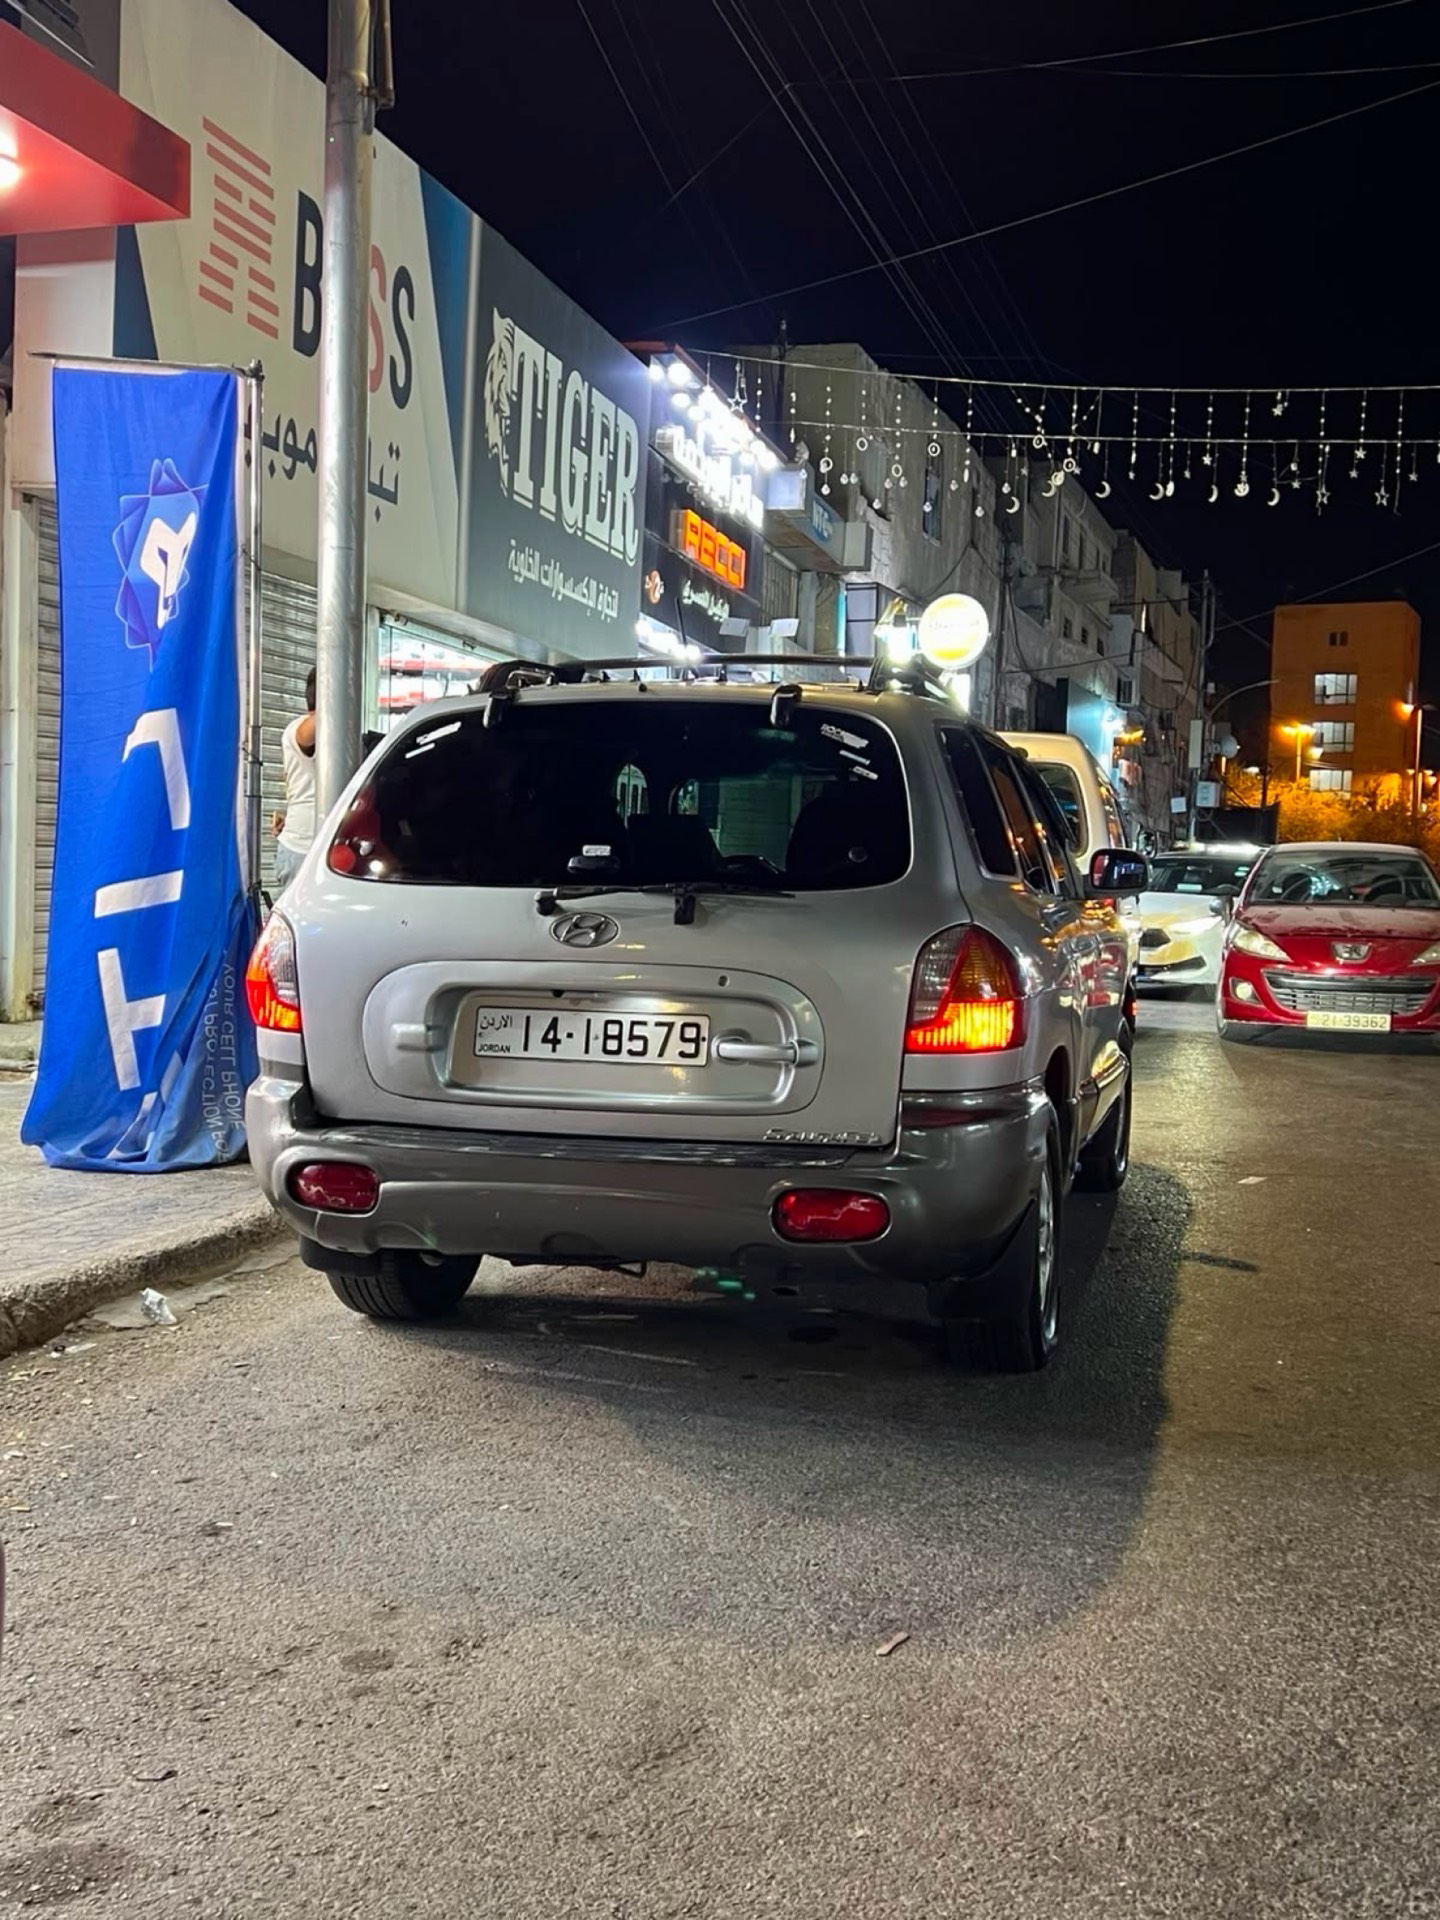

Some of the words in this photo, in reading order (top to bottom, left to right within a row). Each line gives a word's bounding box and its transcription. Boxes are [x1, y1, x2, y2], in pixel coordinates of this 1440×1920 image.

[293, 189, 415, 410] BSS
[511, 325, 640, 567] TIGER
[508, 539, 540, 585] الخلوية
[478, 1043, 511, 1054] JORDAN
